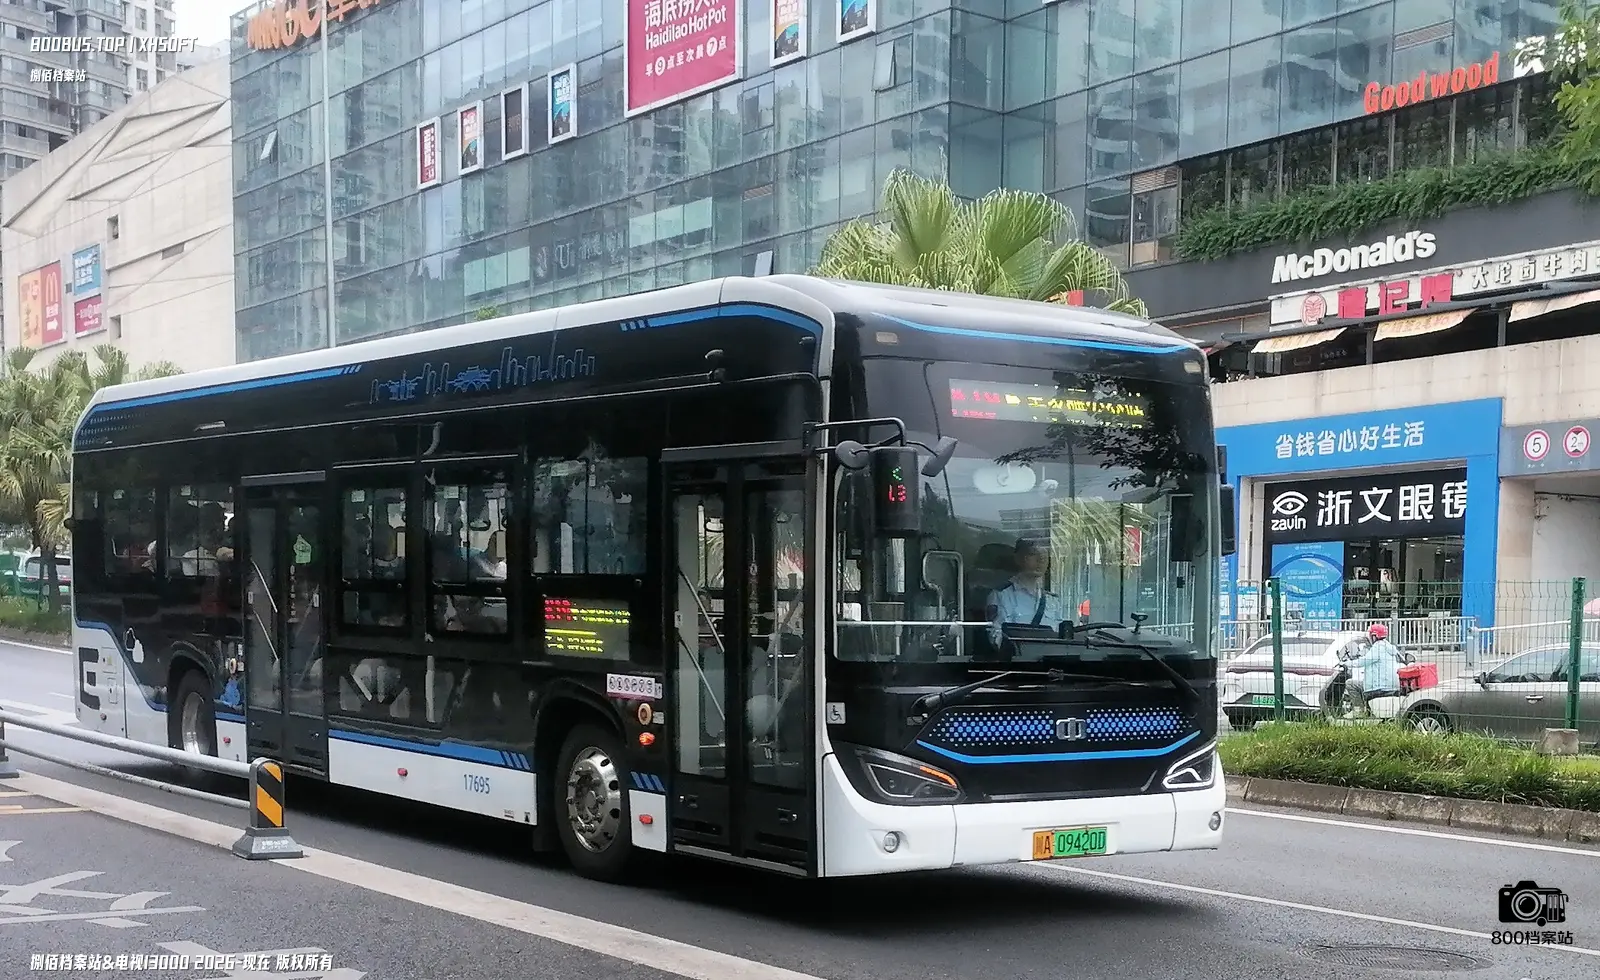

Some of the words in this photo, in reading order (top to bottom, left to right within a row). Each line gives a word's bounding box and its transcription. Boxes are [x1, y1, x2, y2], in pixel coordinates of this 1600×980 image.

[644, 0, 720, 32] 海底捞
[645, 23, 688, 50] Haidilao
[1271, 230, 1437, 284] McDonald's
[1472, 248, 1600, 290] 大坨卤牛肉
[1275, 421, 1425, 459] 省钱省心好生活
[1532, 437, 1542, 454] 5
[1316, 479, 1468, 527] 浙文眼镜
[1271, 514, 1307, 531] zavin
[463, 773, 491, 795] 17695
